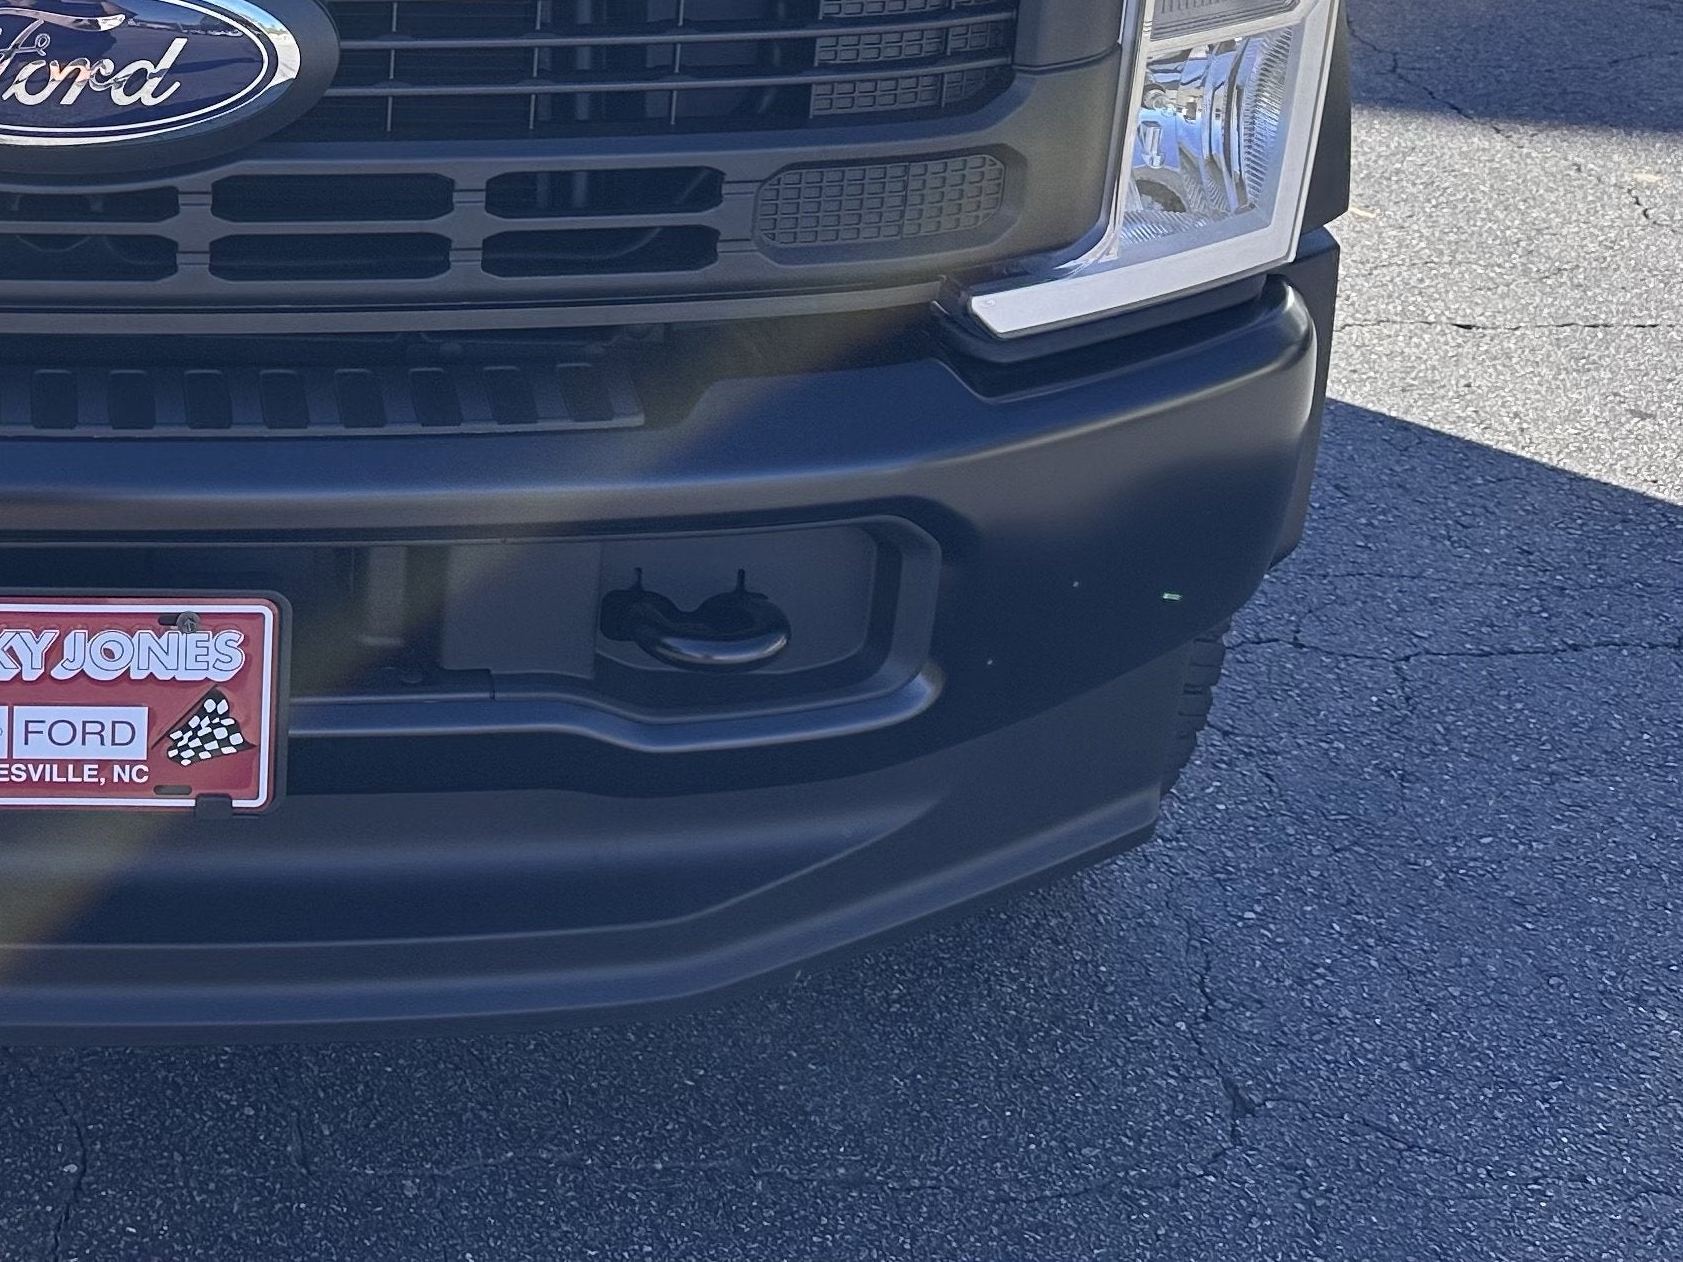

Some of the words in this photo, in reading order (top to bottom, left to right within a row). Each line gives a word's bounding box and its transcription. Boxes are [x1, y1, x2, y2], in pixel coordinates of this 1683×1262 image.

[50, 628, 246, 683] JONES
[23, 719, 136, 748] FORD
[113, 764, 150, 785] NC
